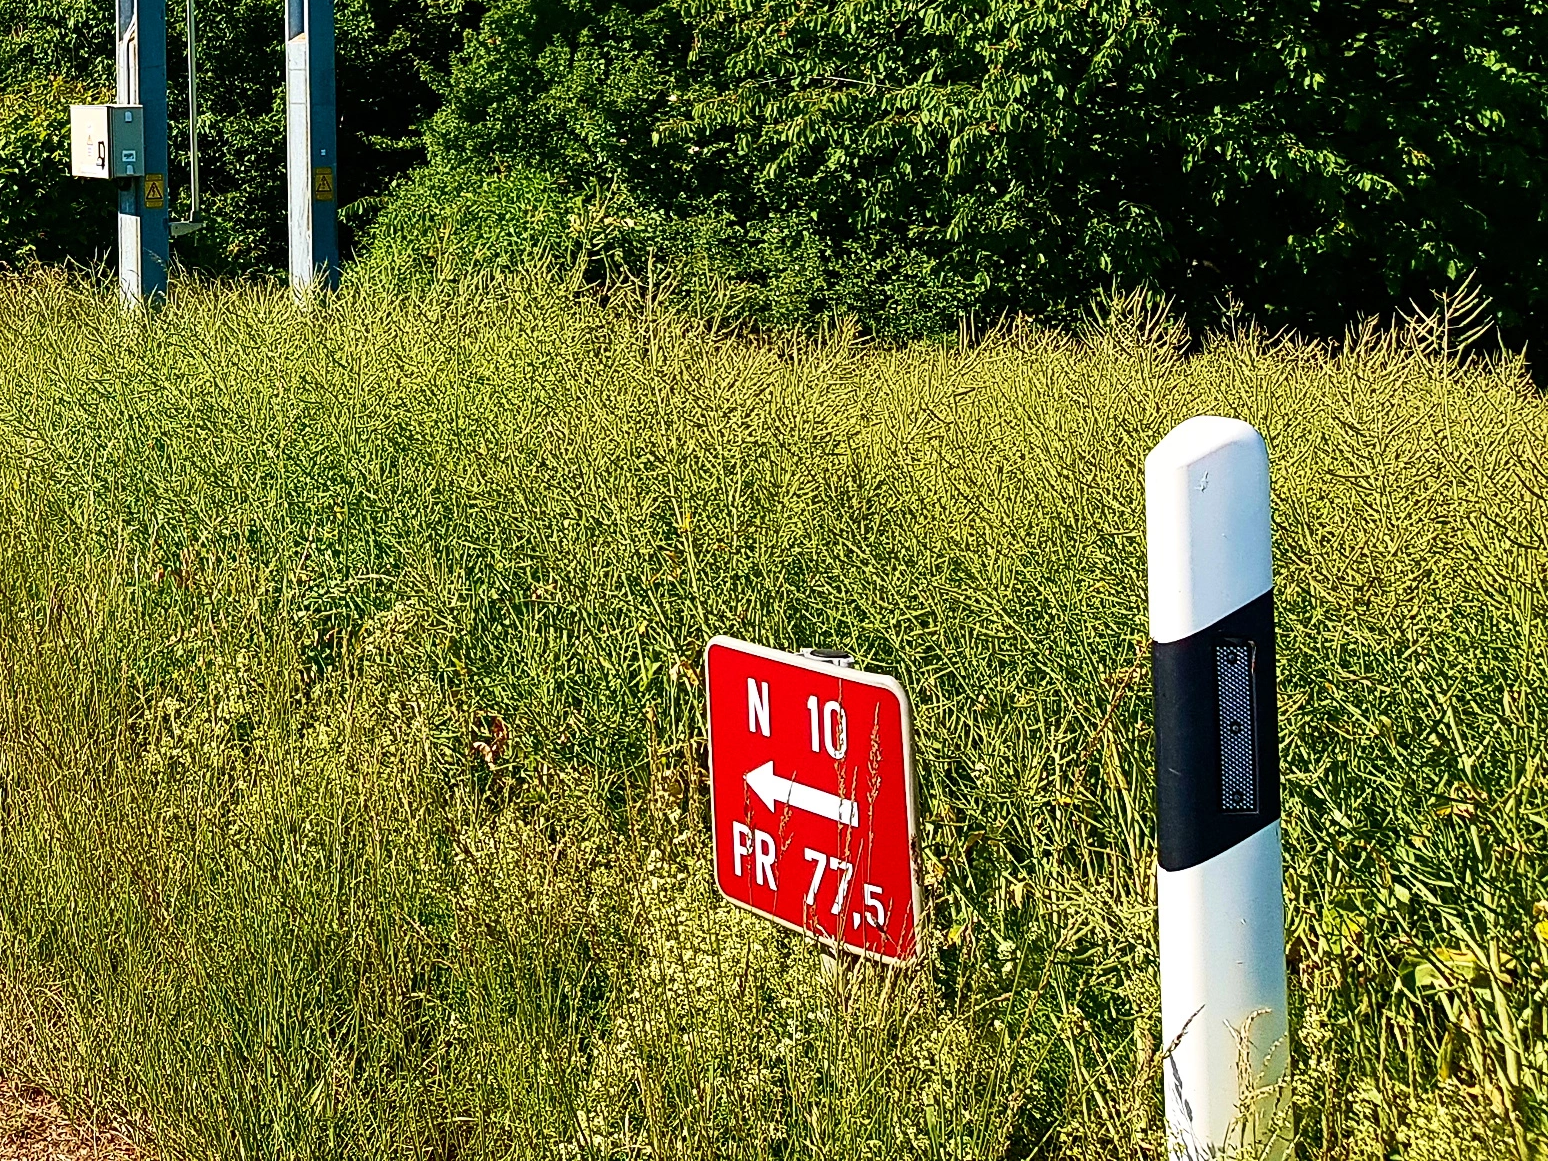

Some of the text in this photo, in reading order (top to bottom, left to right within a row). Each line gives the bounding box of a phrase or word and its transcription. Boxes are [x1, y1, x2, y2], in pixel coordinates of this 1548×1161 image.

[747, 677, 848, 760] N 10
[732, 820, 779, 892] PR
